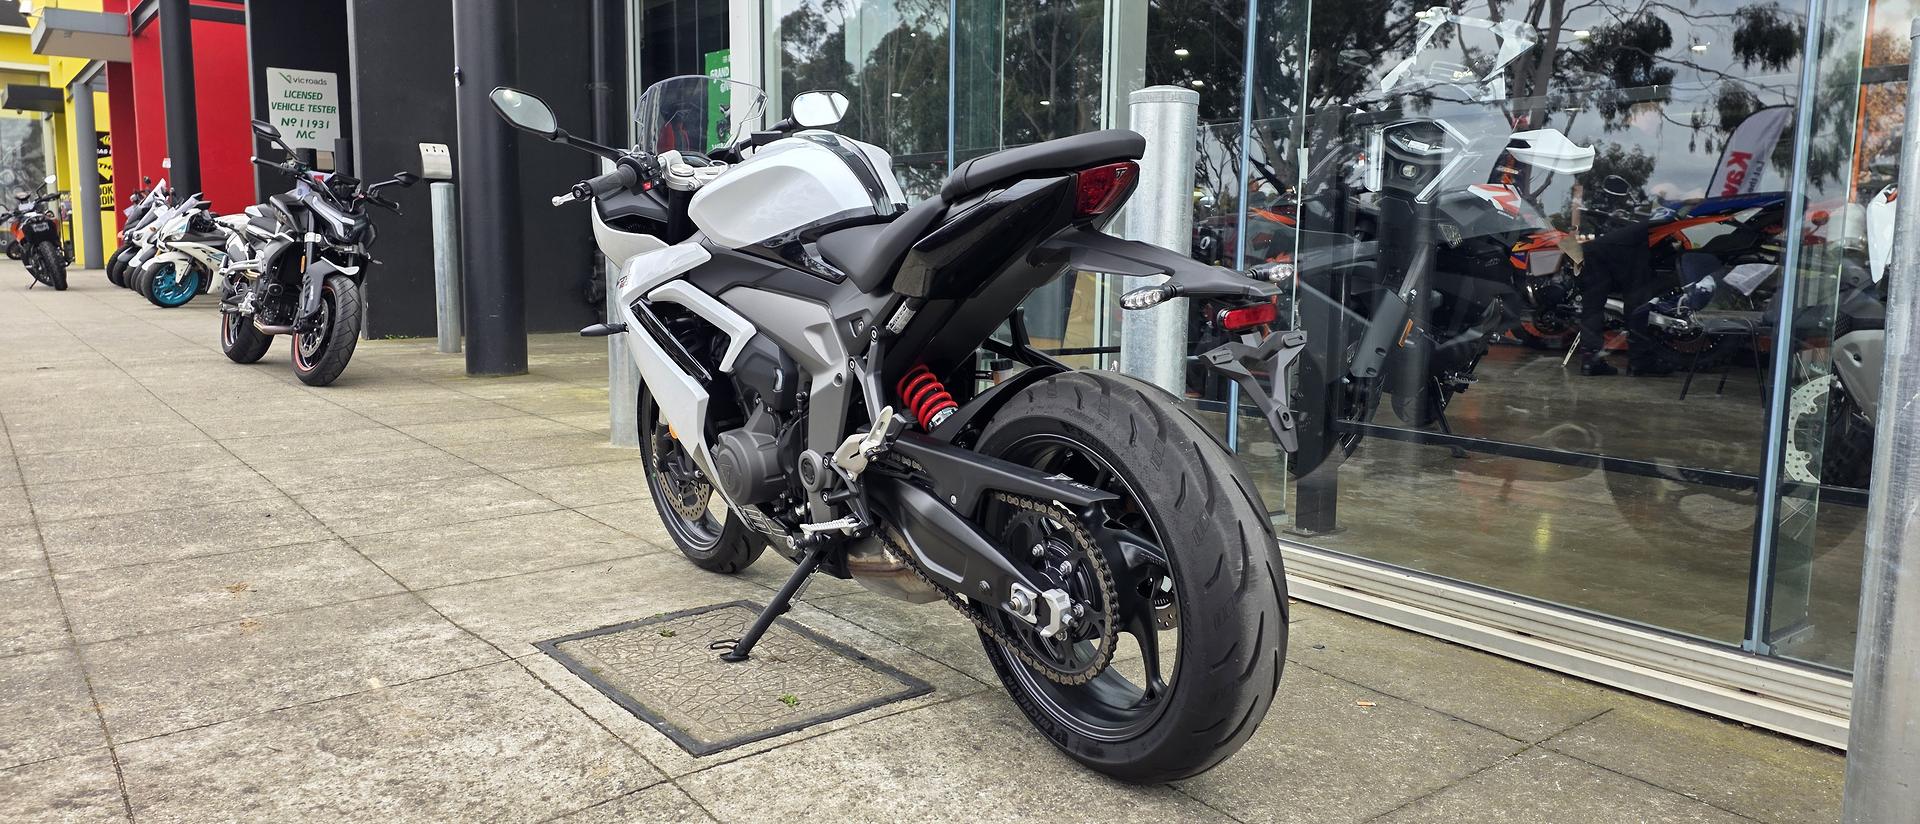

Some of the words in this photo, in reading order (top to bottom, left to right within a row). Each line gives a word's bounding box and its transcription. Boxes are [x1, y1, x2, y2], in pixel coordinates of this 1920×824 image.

[284, 89, 323, 100] LICENSED
[271, 102, 305, 111] VEHICLE
[307, 104, 336, 113] TESTER
[300, 119, 330, 128] 11931
[296, 130, 316, 139] MC
[1004, 675, 1053, 731] MICHELIN
